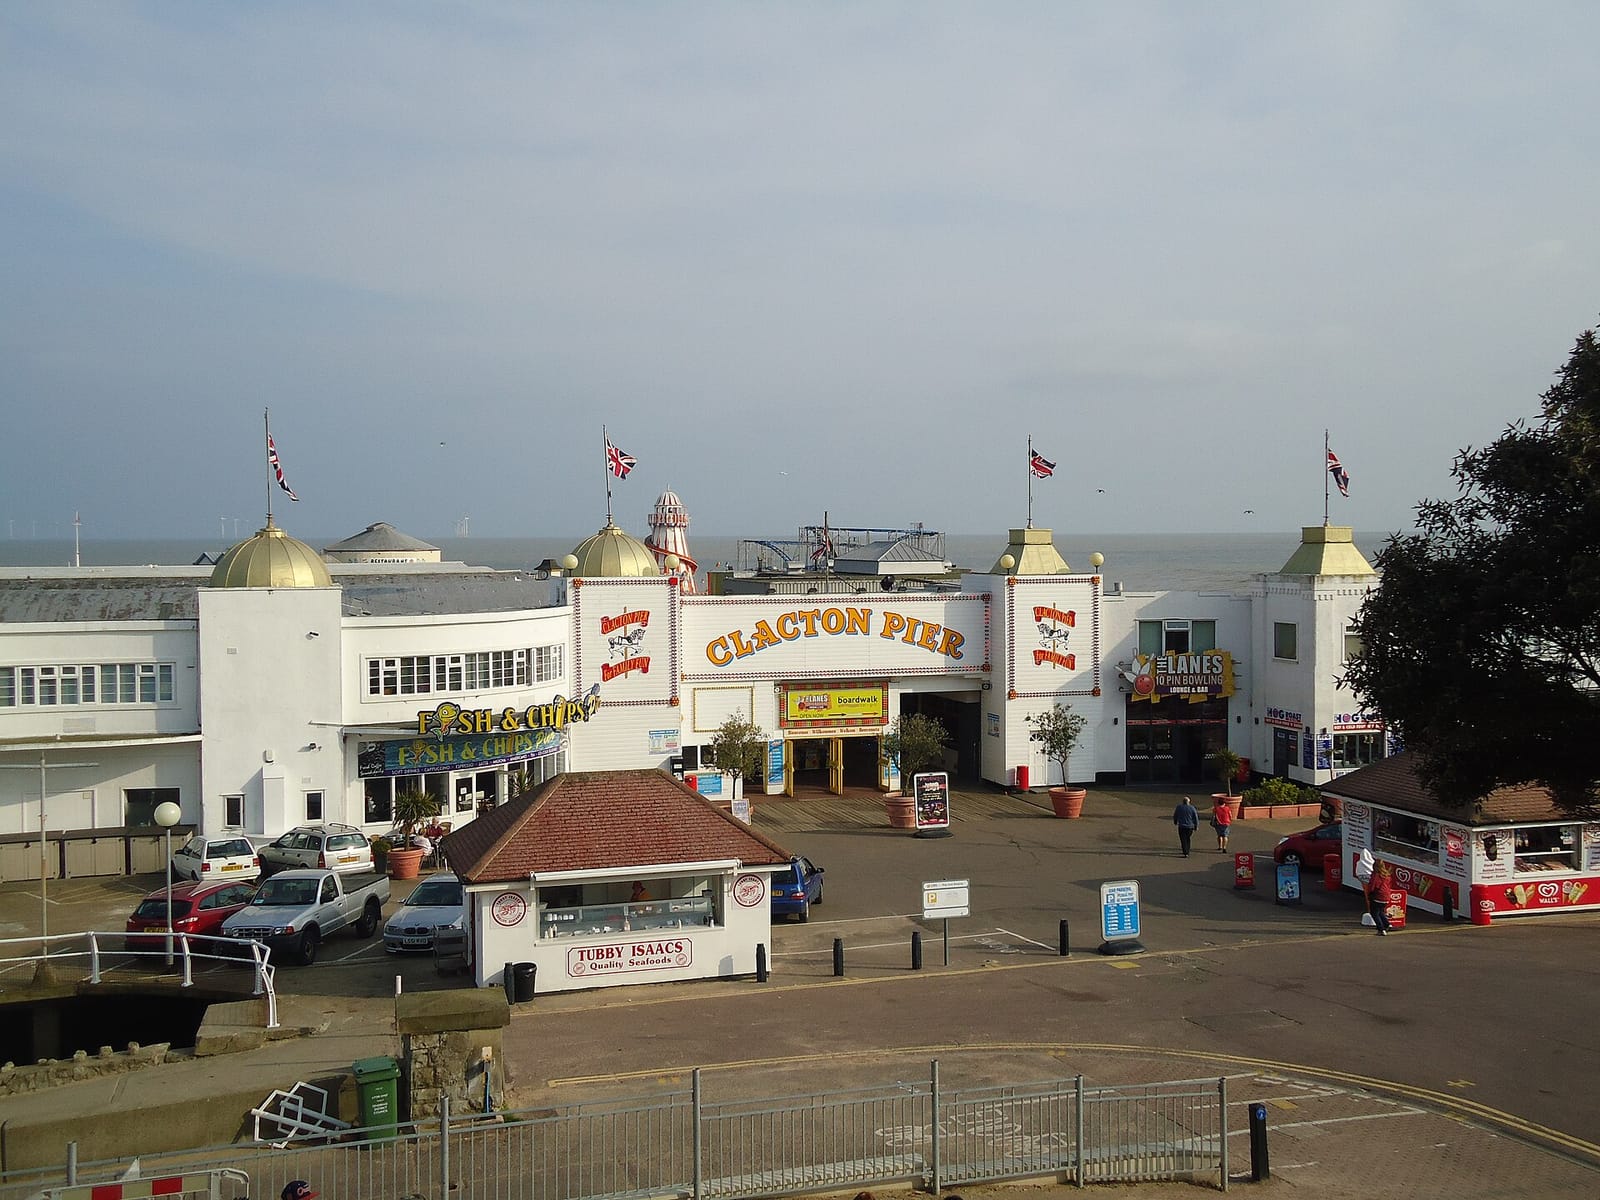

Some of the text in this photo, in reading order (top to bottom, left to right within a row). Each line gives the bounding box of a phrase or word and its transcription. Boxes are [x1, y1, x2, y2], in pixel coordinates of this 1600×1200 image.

[602, 613, 633, 634] CLACTON
[705, 607, 966, 668] CLACTON PIER
[1156, 655, 1223, 674] THE LANES
[1156, 674, 1223, 686] 10 PIN BOWLING
[837, 695, 878, 704] boardwalk
[502, 704, 520, 732] &
[526, 695, 586, 734] CHIPS
[1267, 706, 1285, 720] HOG
[1333, 712, 1360, 724] HOG
[461, 741, 477, 760] &
[482, 732, 533, 757] CHIPS
[928, 893, 936, 904] P
[577, 941, 683, 962] TUBBY ISAACS
[589, 956, 672, 970] Quality Seafoods
